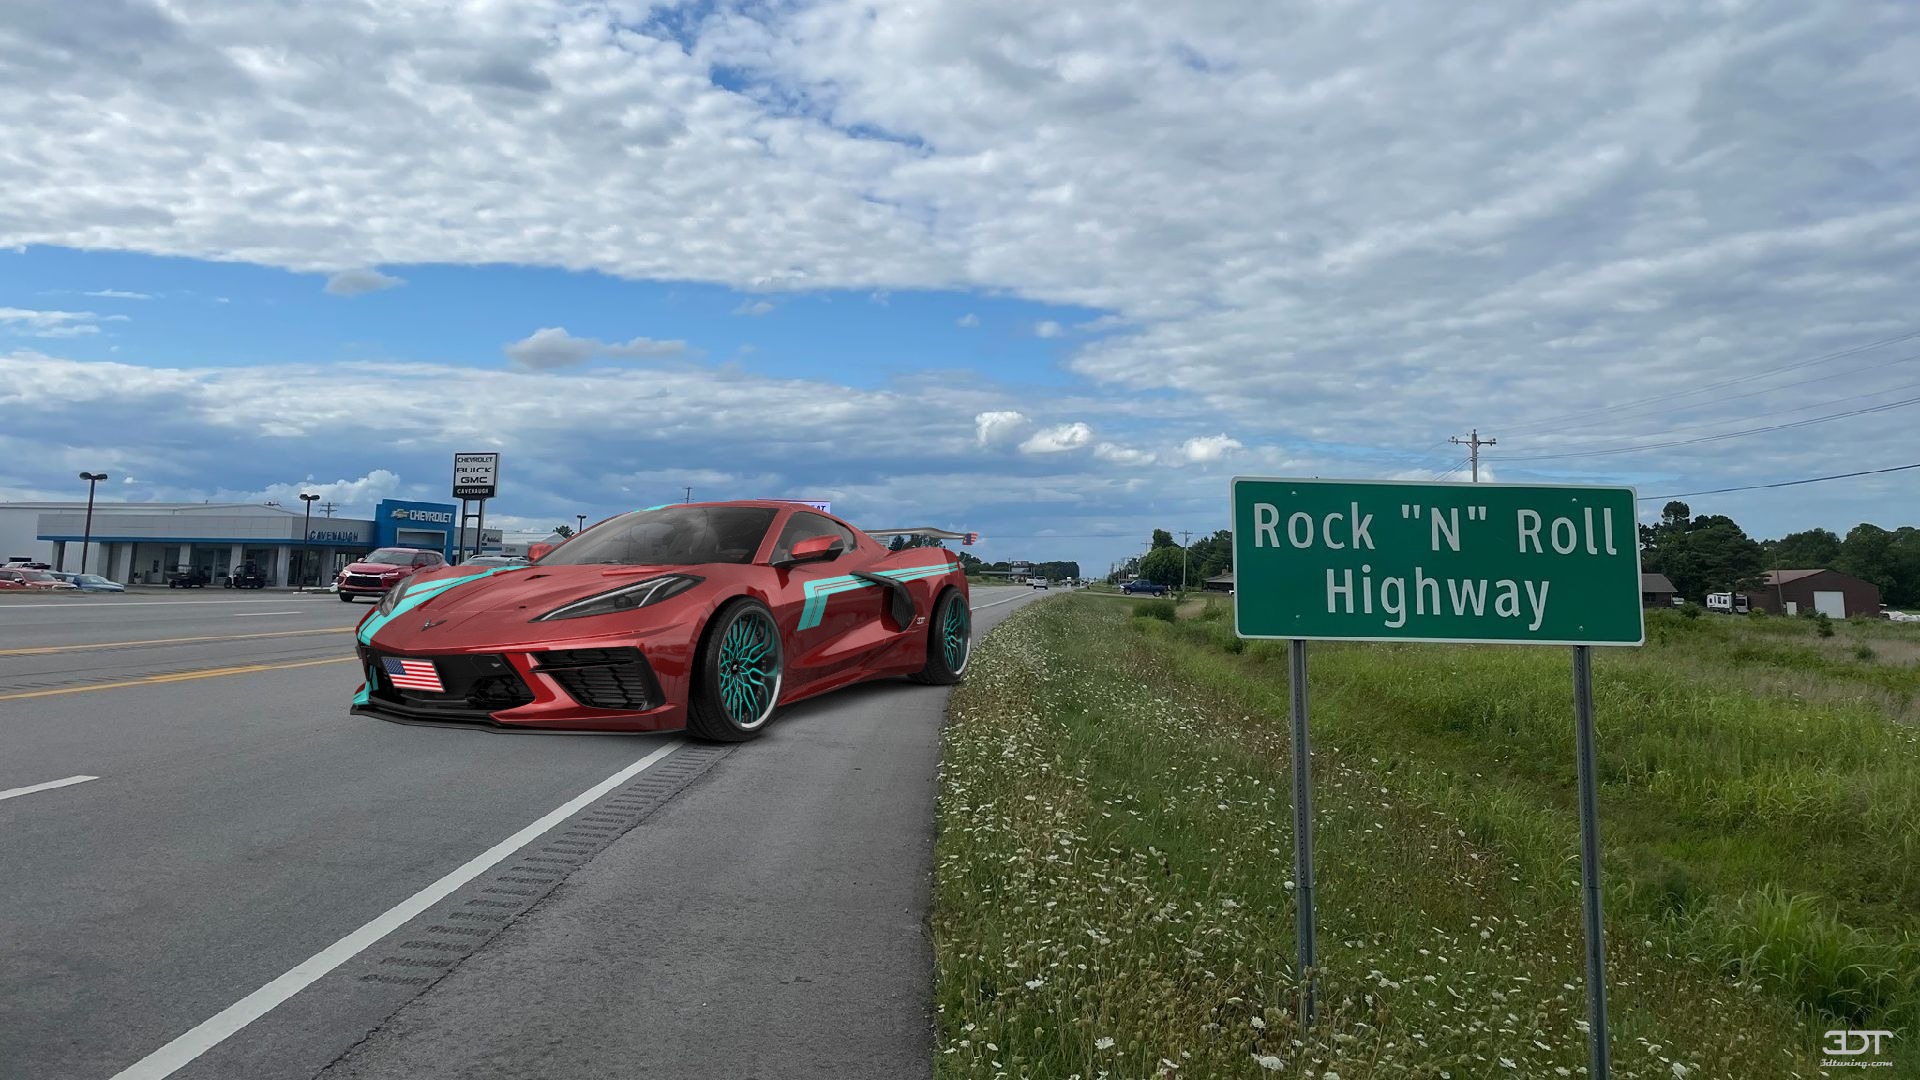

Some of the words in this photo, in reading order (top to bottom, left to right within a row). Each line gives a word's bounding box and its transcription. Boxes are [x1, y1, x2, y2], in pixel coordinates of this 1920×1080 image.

[460, 476, 488, 484] GMC
[409, 509, 453, 523] CHEVROLET
[1253, 501, 1376, 550] Rock
[1401, 504, 1487, 552] "N"
[1517, 507, 1617, 555] Roll
[309, 530, 358, 541] CAVENAUGH
[1326, 564, 1550, 631] Highway
